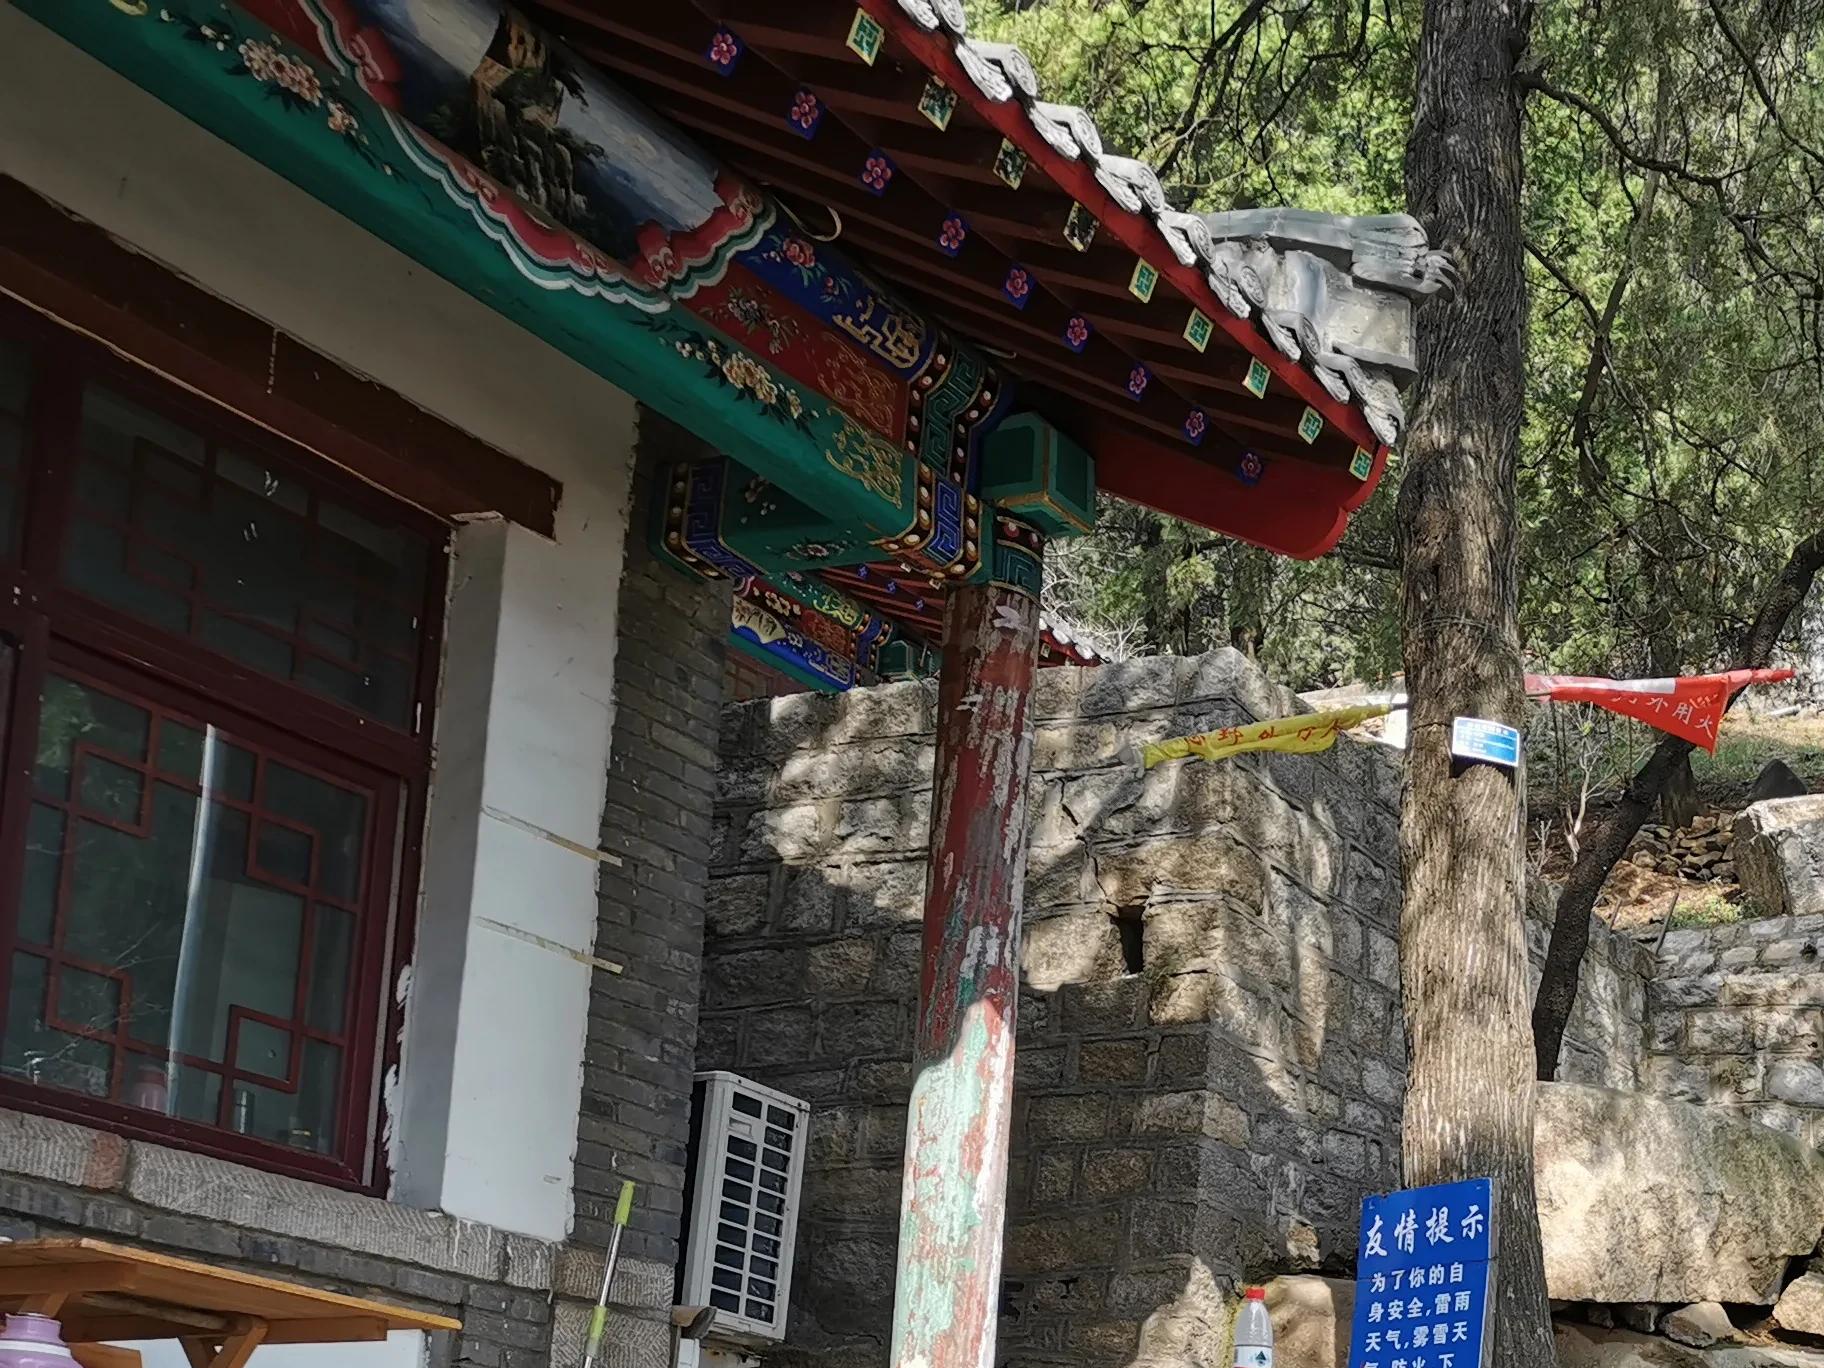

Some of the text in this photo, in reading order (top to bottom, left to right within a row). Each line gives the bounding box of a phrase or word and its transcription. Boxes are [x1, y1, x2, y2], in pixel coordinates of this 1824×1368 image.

[1364, 1204, 1484, 1259] 友情提示
[1370, 1261, 1464, 1293] 为了你的自
[1367, 1290, 1472, 1323] 身安全,雷雨
[1365, 1321, 1468, 1353] 天气,雾雪天
